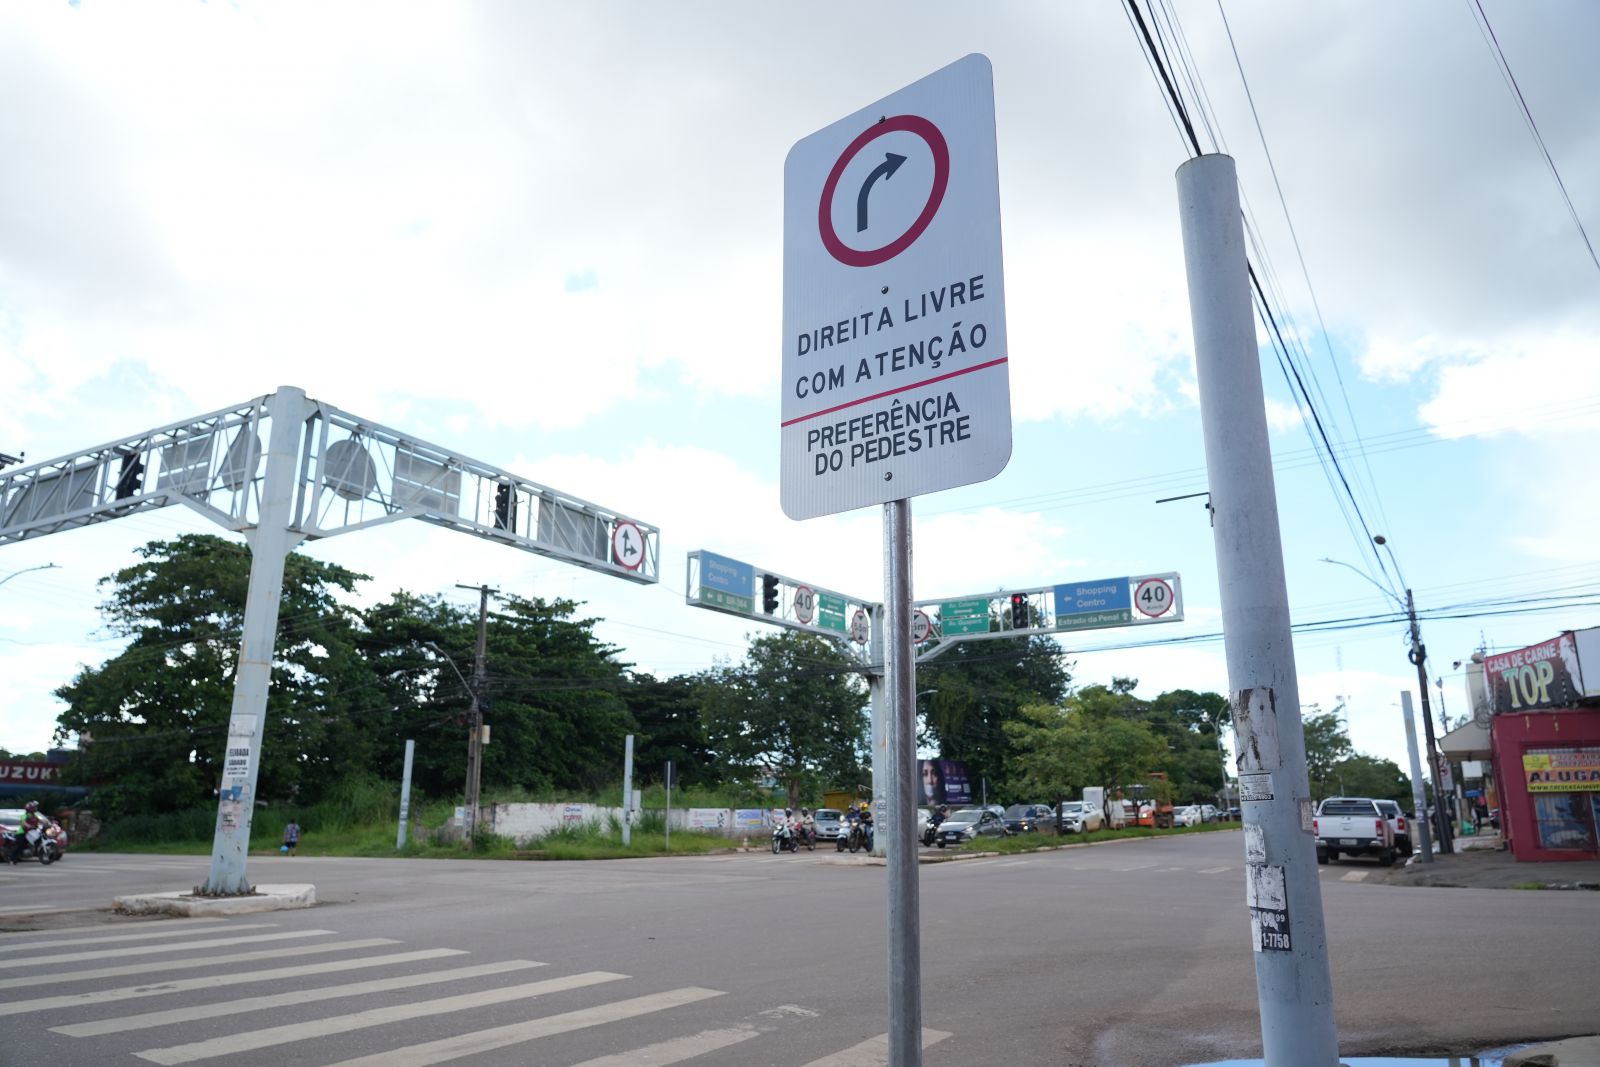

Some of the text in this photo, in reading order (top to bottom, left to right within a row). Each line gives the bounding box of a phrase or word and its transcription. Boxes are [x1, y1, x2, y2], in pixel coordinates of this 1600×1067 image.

[797, 274, 985, 357] DIREITA LIVRE
[795, 321, 987, 399] COM ATENÇÃO
[807, 391, 961, 452] PREFERÊNCIA
[815, 415, 971, 476] DO PEDESTRE
[796, 593, 812, 610] 40
[1076, 585, 1117, 597] Shopping
[1141, 586, 1165, 602] 40
[1076, 598, 1105, 608] Centro
[1058, 616, 1086, 626] Estrada
[1099, 613, 1120, 622] Penal
[1487, 643, 1556, 673] CASA DE CARNE
[1501, 661, 1554, 708] TOP
[1530, 770, 1600, 782] ALUGA
